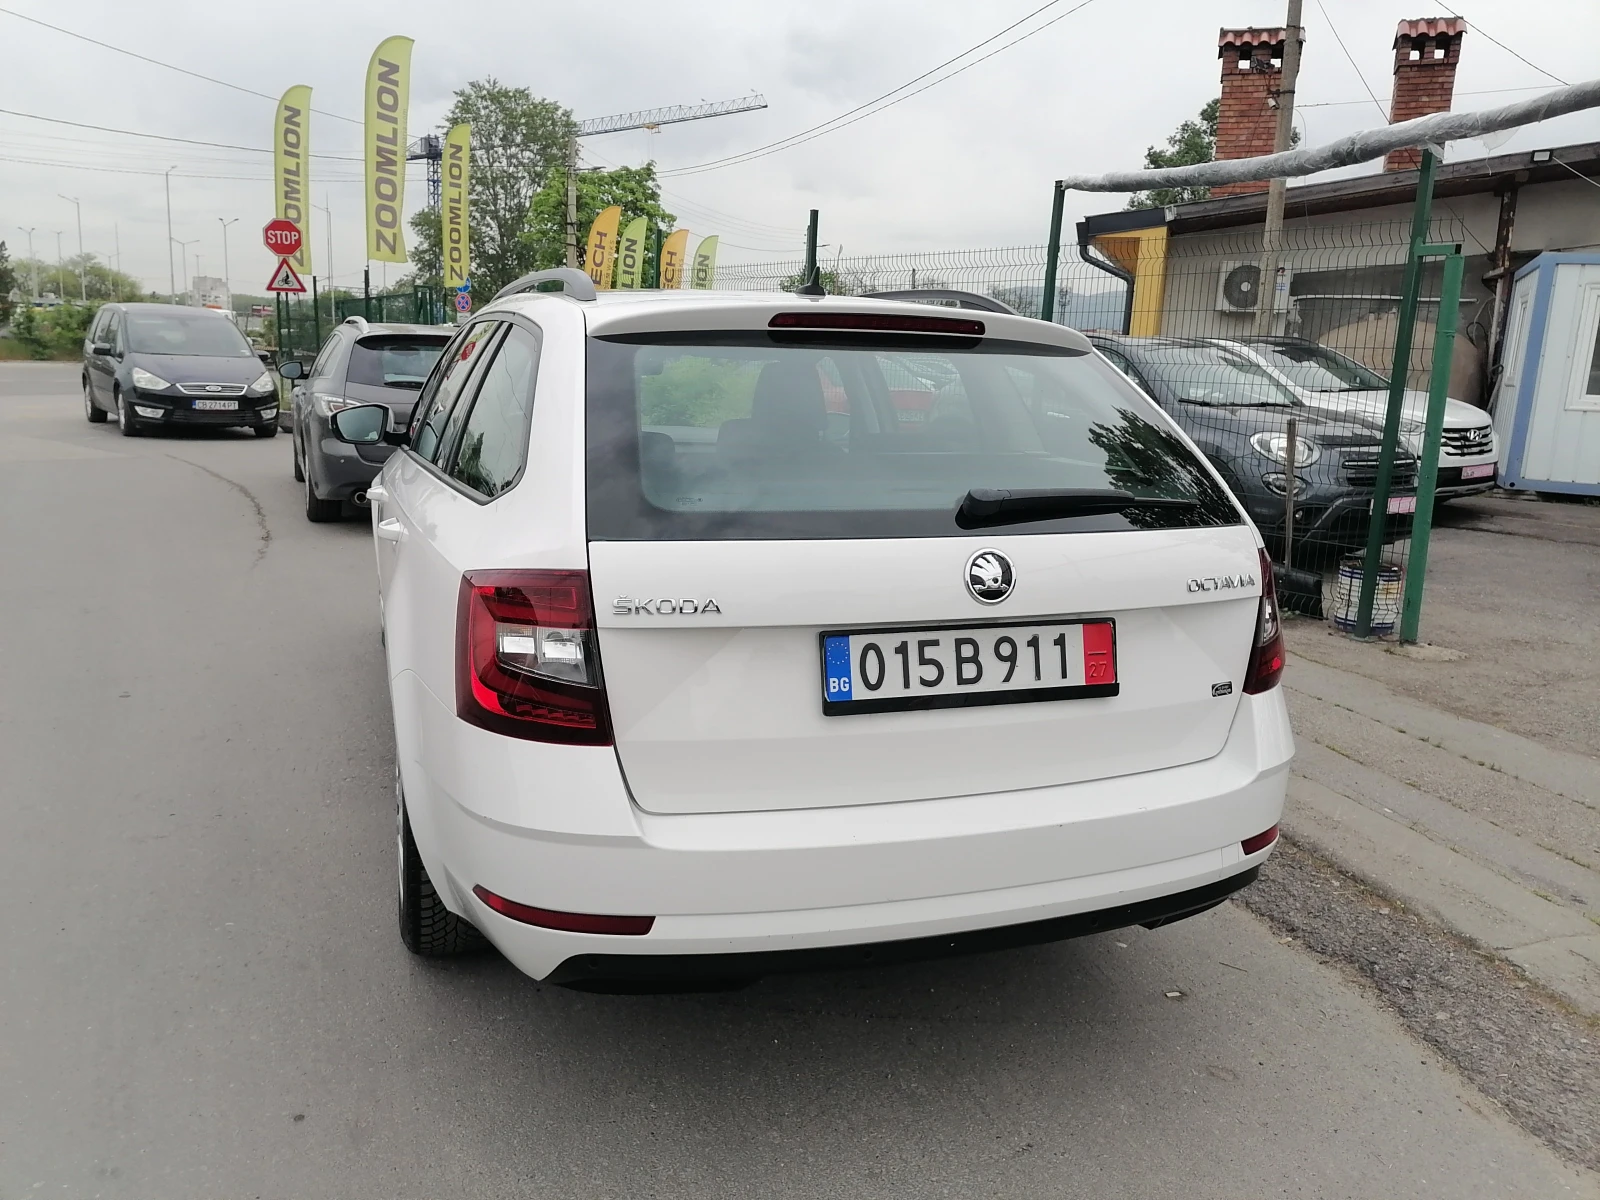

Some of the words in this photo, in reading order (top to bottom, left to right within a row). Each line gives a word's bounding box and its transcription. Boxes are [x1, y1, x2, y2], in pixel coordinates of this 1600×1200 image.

[375, 58, 400, 255] ZOOMLION
[284, 104, 305, 267] ZOMLION
[449, 142, 464, 281] ZOOMLION
[267, 230, 299, 245] STOP
[1187, 574, 1255, 592] OCTAVIA
[612, 594, 722, 615] ŠKODA
[829, 676, 850, 693] BG
[1089, 661, 1107, 677] 27
